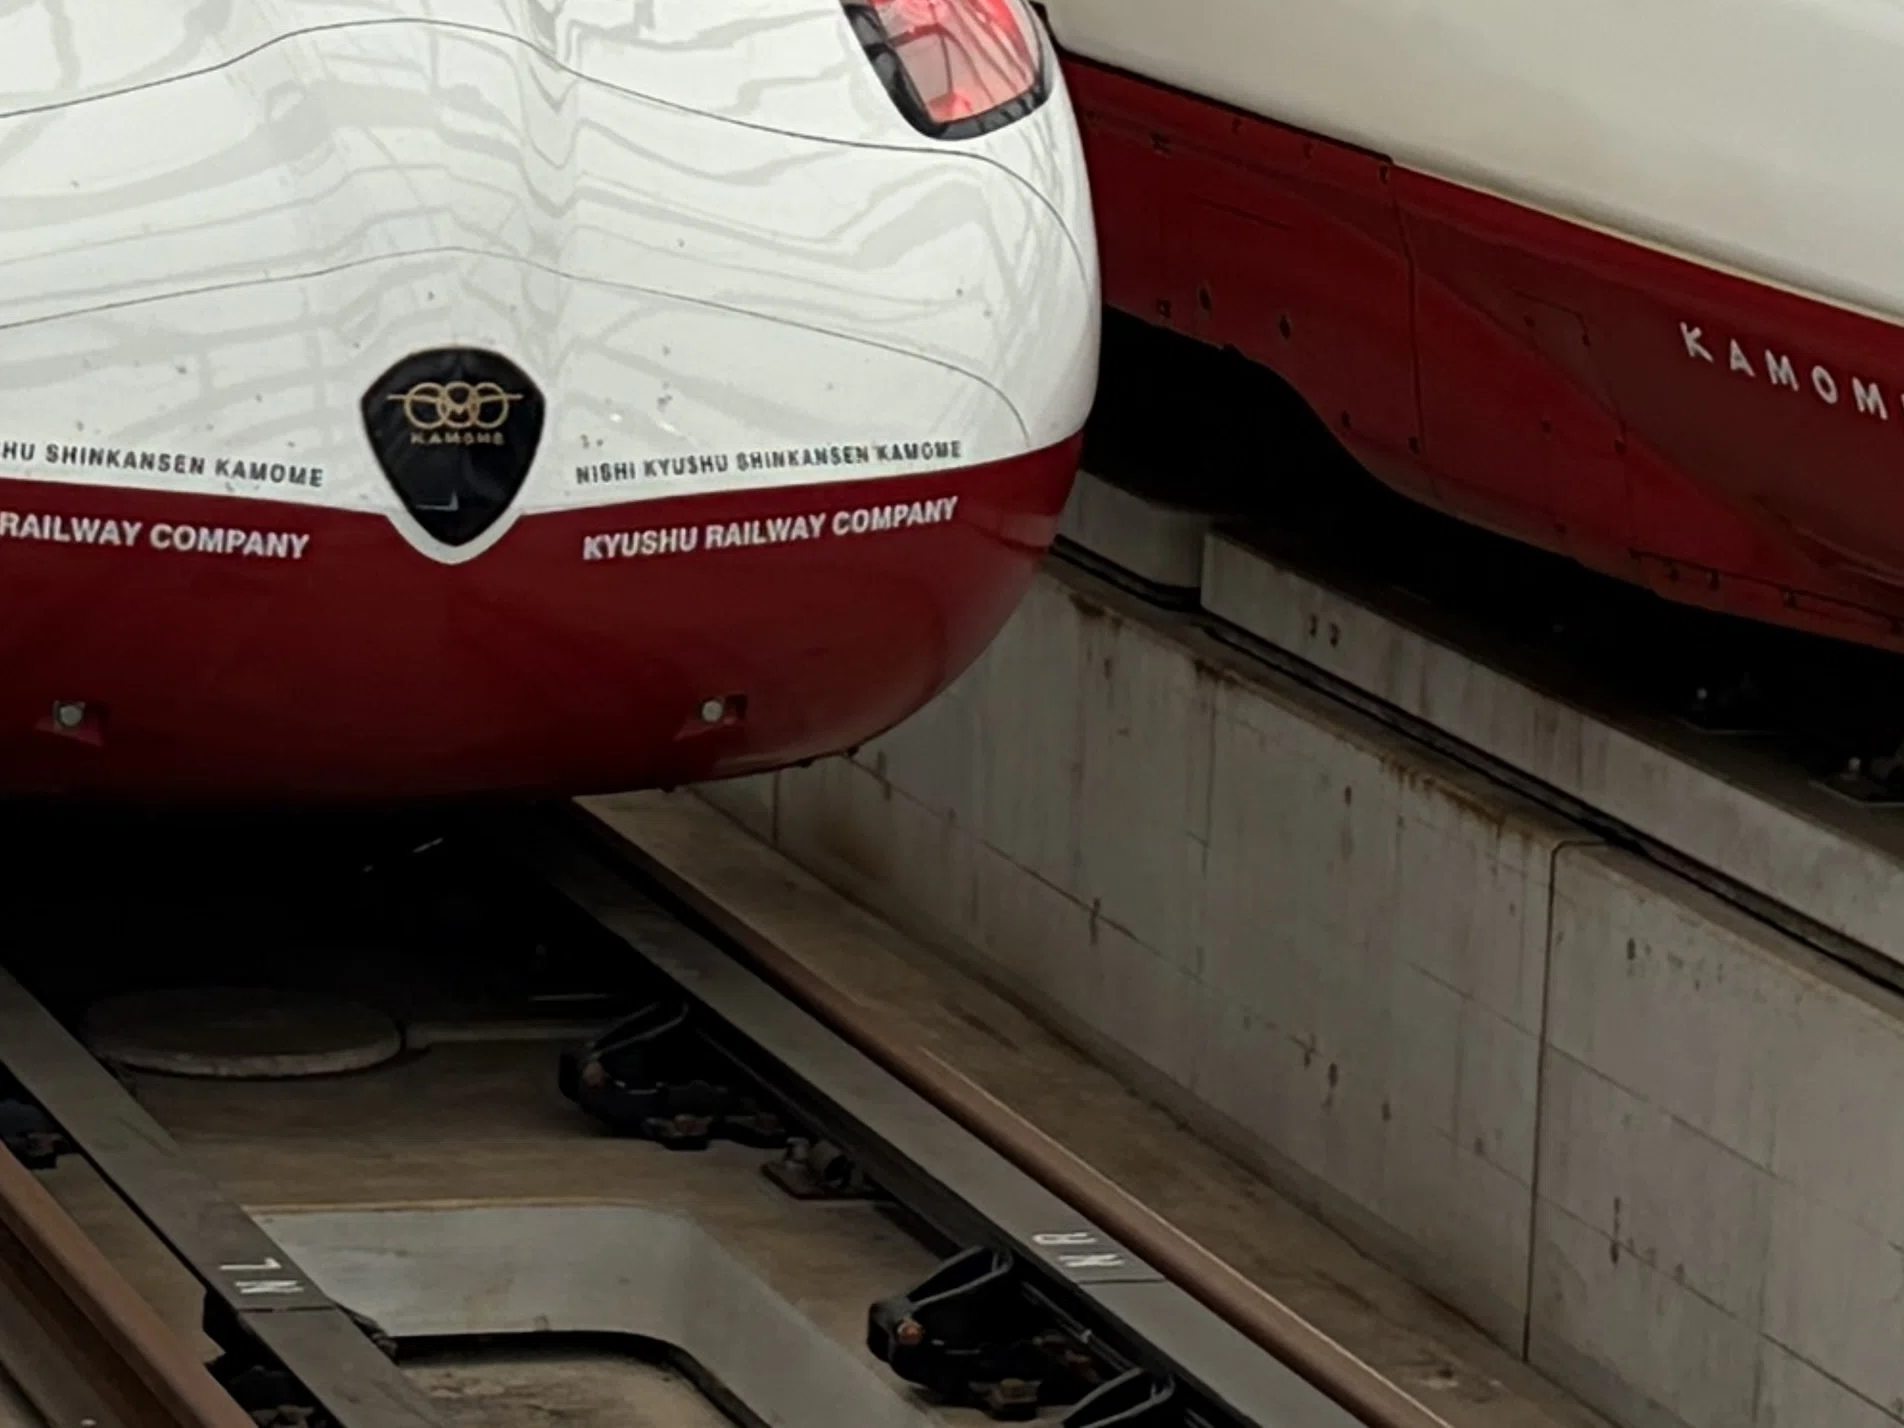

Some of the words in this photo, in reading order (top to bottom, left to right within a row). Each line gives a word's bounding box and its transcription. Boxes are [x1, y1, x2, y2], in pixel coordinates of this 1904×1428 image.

[45, 443, 206, 477] SHINKANSEN
[214, 457, 326, 489] KAMOME
[575, 460, 637, 486] NISHI
[643, 453, 729, 478] KYUSHU
[735, 445, 871, 473] SHINKANSEN
[876, 439, 963, 463] KAMOME
[149, 522, 311, 560] COMPANY
[582, 522, 698, 561] KYUSHU
[704, 512, 827, 550] RAILWAY
[831, 495, 959, 537] COMPANY
